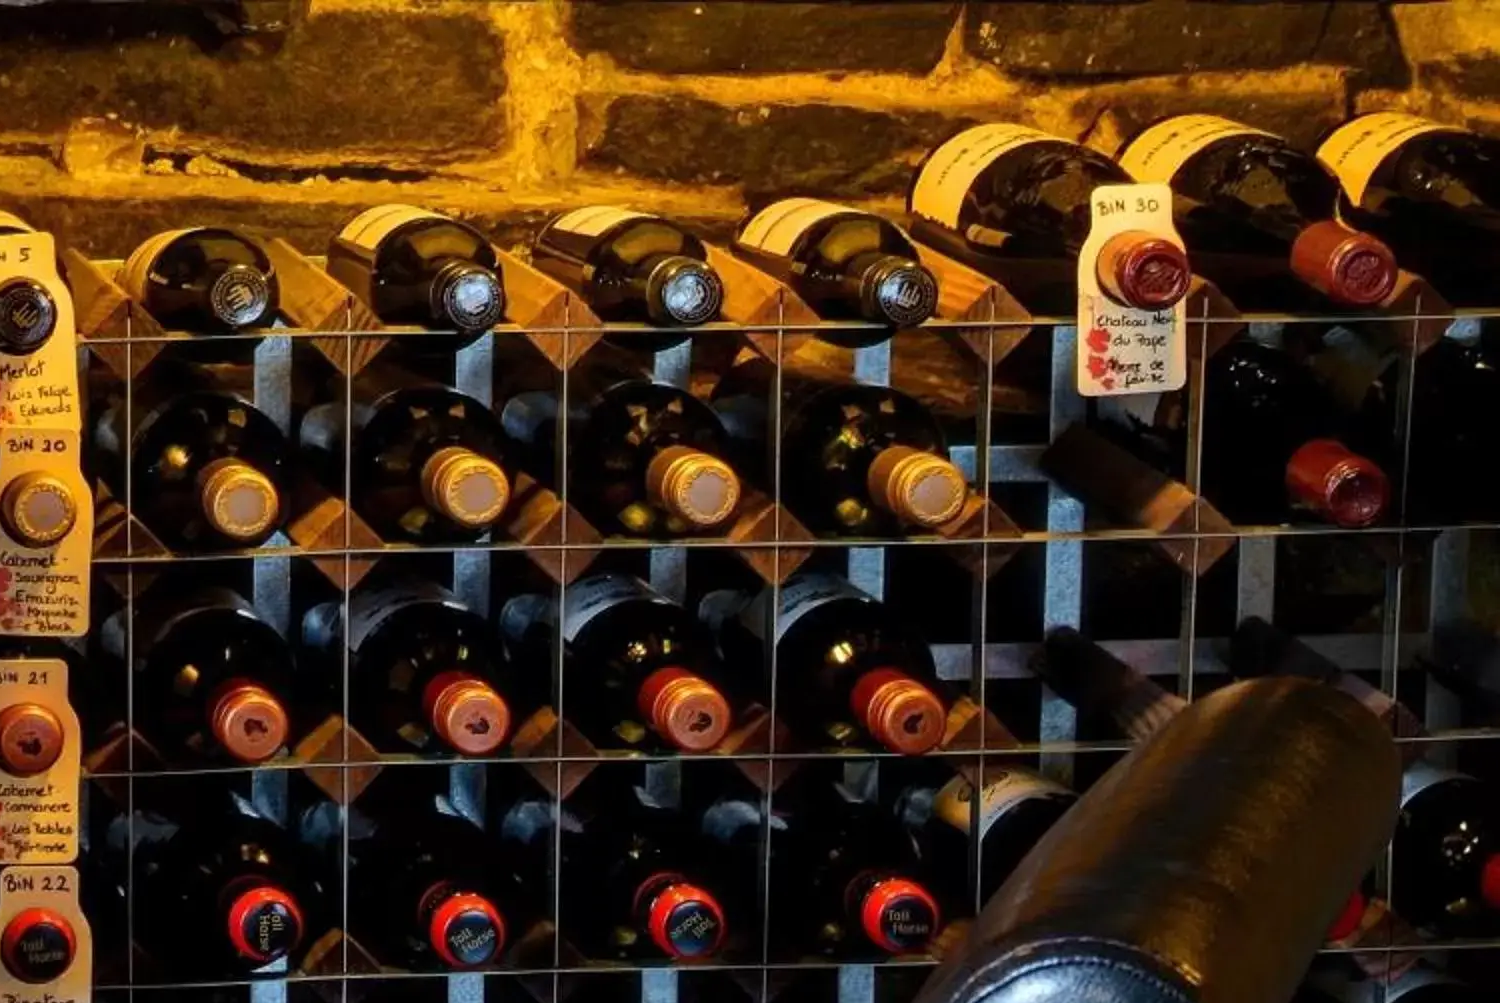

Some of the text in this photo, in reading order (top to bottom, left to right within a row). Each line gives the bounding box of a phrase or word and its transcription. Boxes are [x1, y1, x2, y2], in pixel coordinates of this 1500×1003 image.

[1135, 198, 1160, 213] 30
[19, 247, 31, 262] 5
[1096, 315, 1147, 329] Chateau
[1113, 333, 1167, 354] du Pape
[0, 361, 45, 381] Merlot
[41, 439, 67, 453] 20
[27, 671, 48, 685] 21
[41, 875, 71, 892] 22
